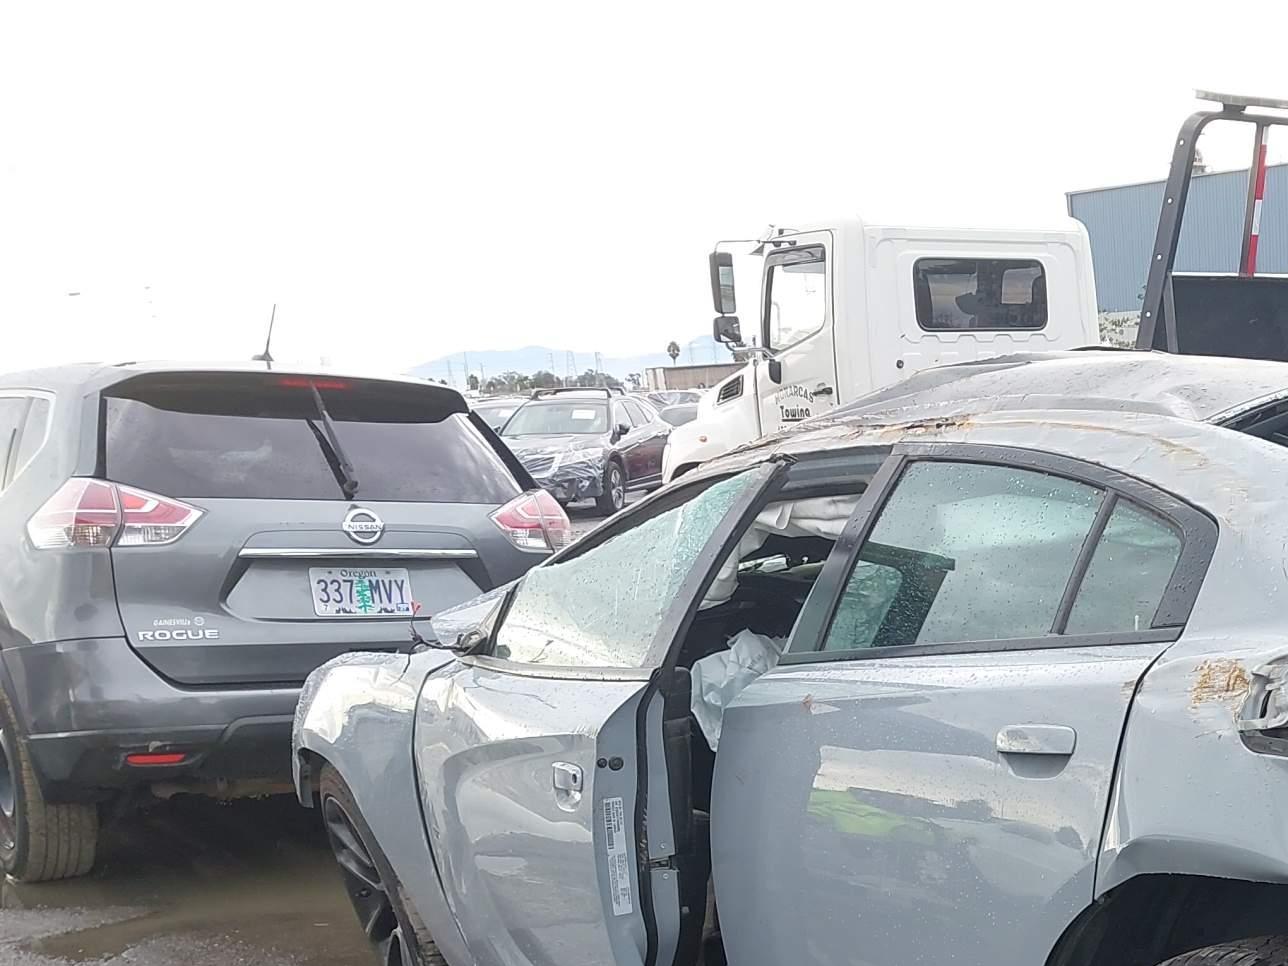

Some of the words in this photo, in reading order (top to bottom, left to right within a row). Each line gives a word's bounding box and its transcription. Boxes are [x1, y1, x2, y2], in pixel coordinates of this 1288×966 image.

[340, 569, 377, 578] Oregon
[317, 579, 354, 604] 337
[368, 579, 405, 604] MVY
[138, 629, 221, 641] ROGUE
